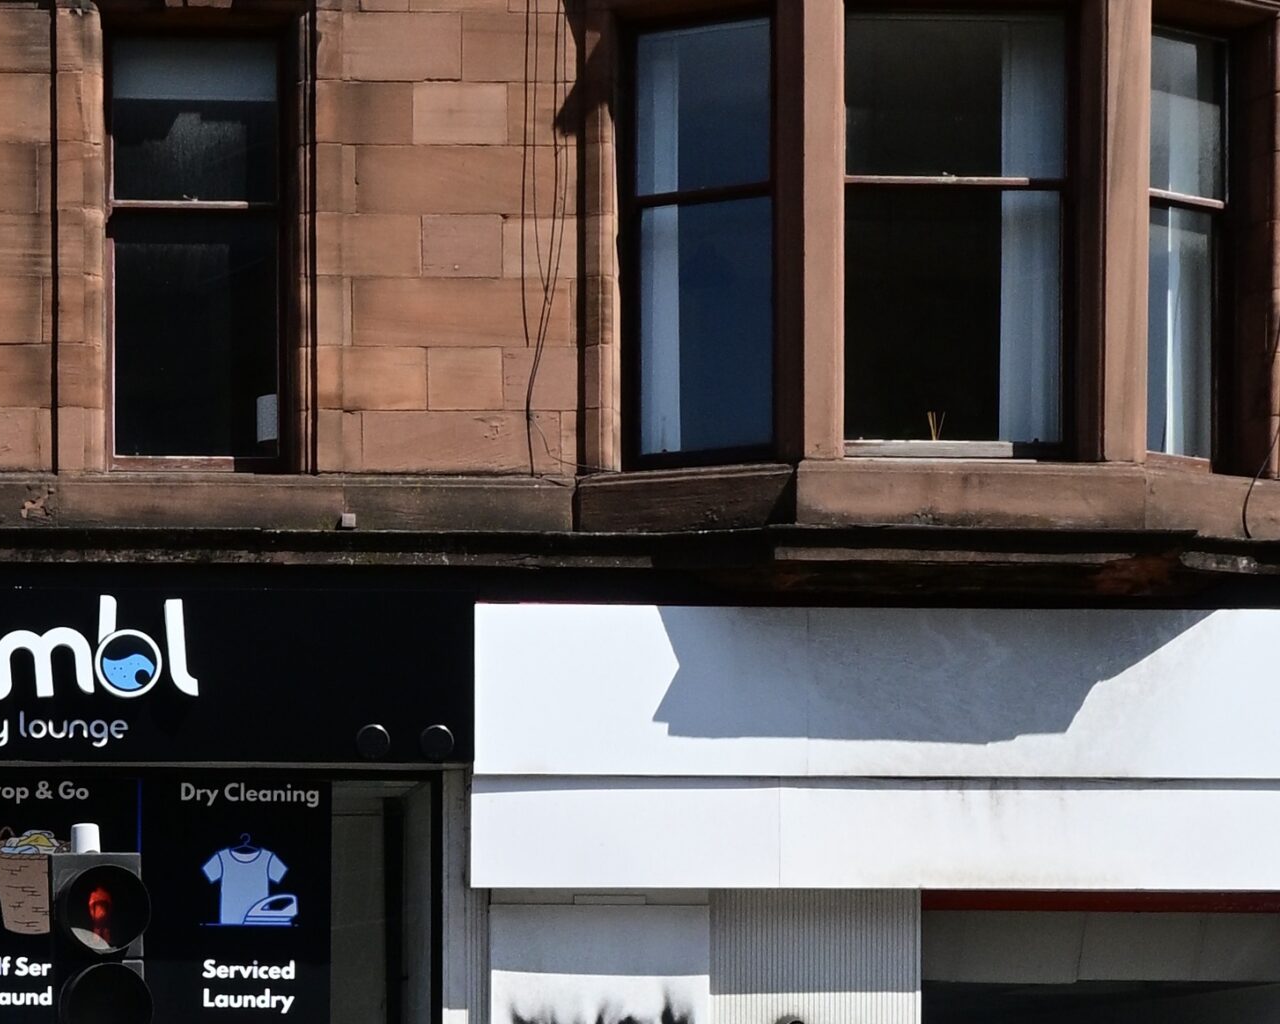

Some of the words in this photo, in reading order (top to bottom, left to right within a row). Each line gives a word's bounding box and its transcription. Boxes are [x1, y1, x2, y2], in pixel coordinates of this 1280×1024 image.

[20, 710, 129, 748] lounge
[35, 780, 53, 800] &
[58, 780, 90, 800] Go
[180, 782, 219, 806] Dry
[223, 782, 321, 807] Cleaning
[202, 958, 296, 980] Serviced
[202, 988, 295, 1015] Laundry
